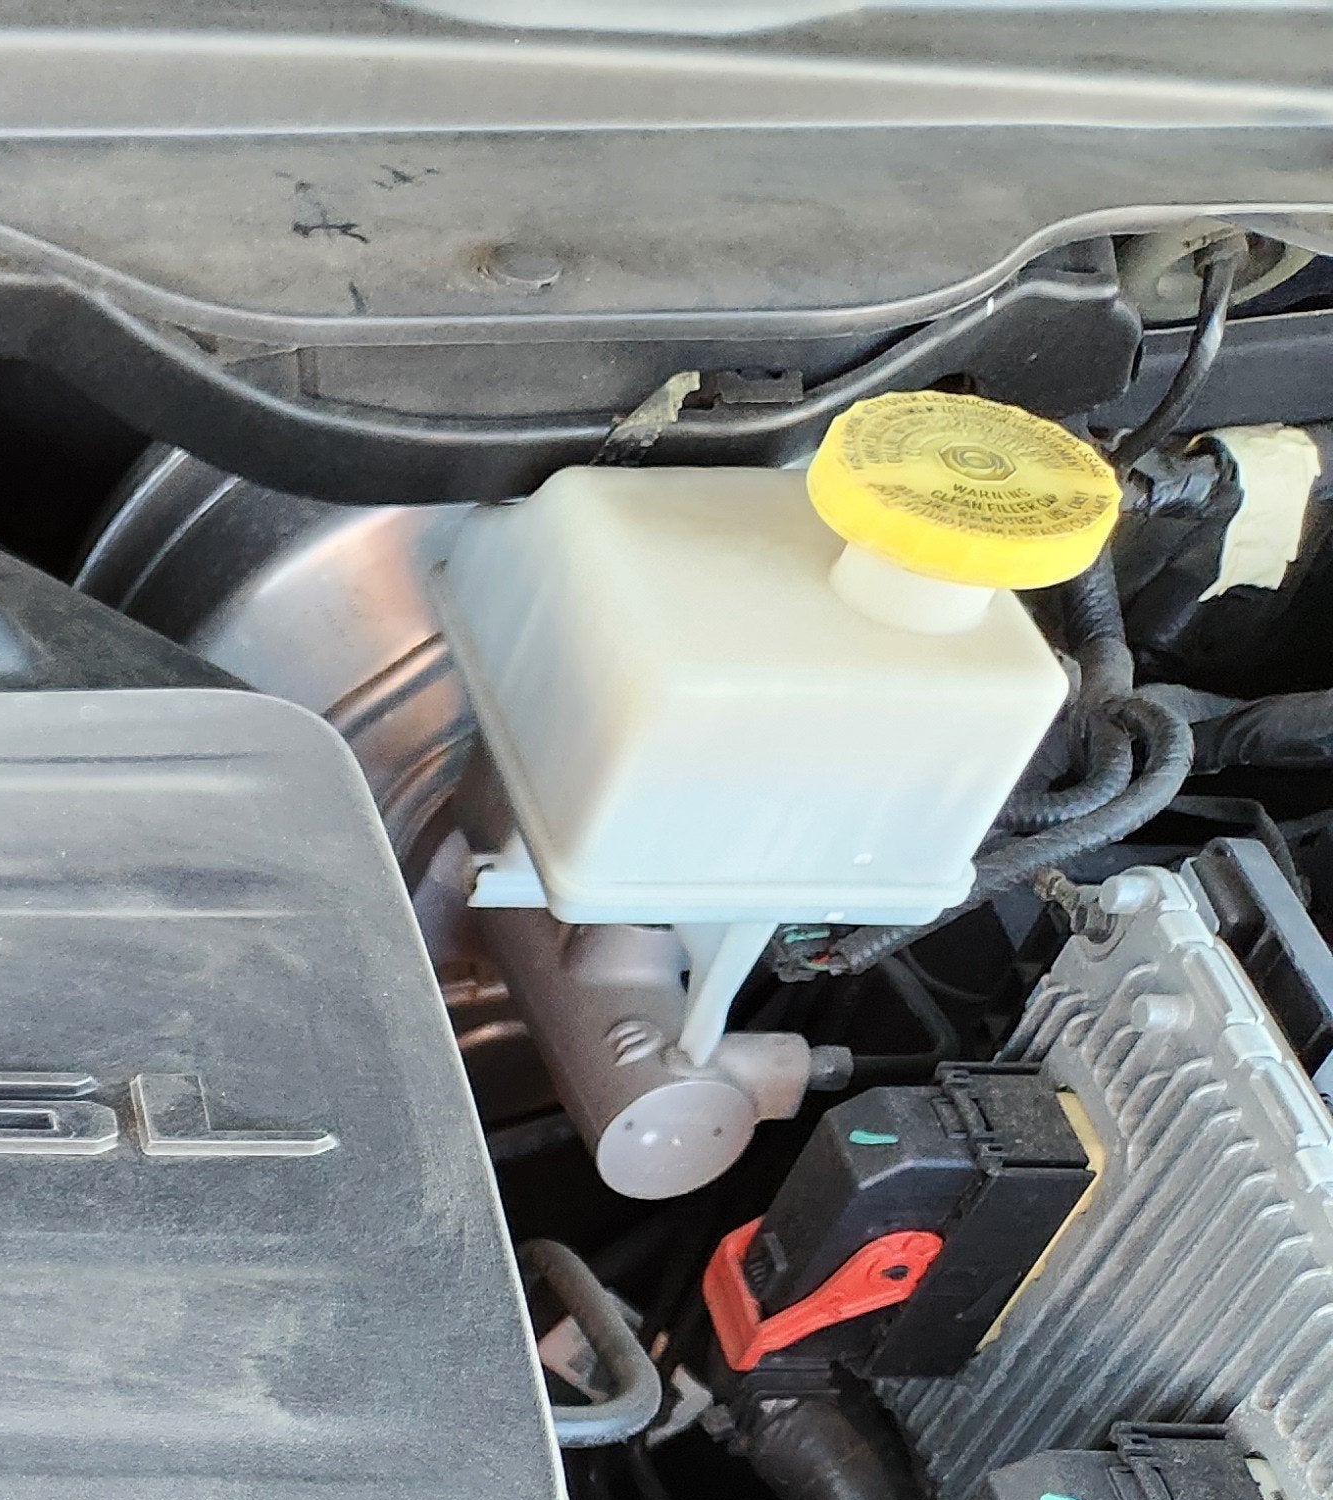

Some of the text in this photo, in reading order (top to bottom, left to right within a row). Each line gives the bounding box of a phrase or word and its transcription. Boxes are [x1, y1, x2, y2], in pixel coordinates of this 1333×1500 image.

[930, 489, 982, 511] CLEAN
[987, 501, 1037, 514] FILLER
[952, 483, 1031, 500] WARNING
